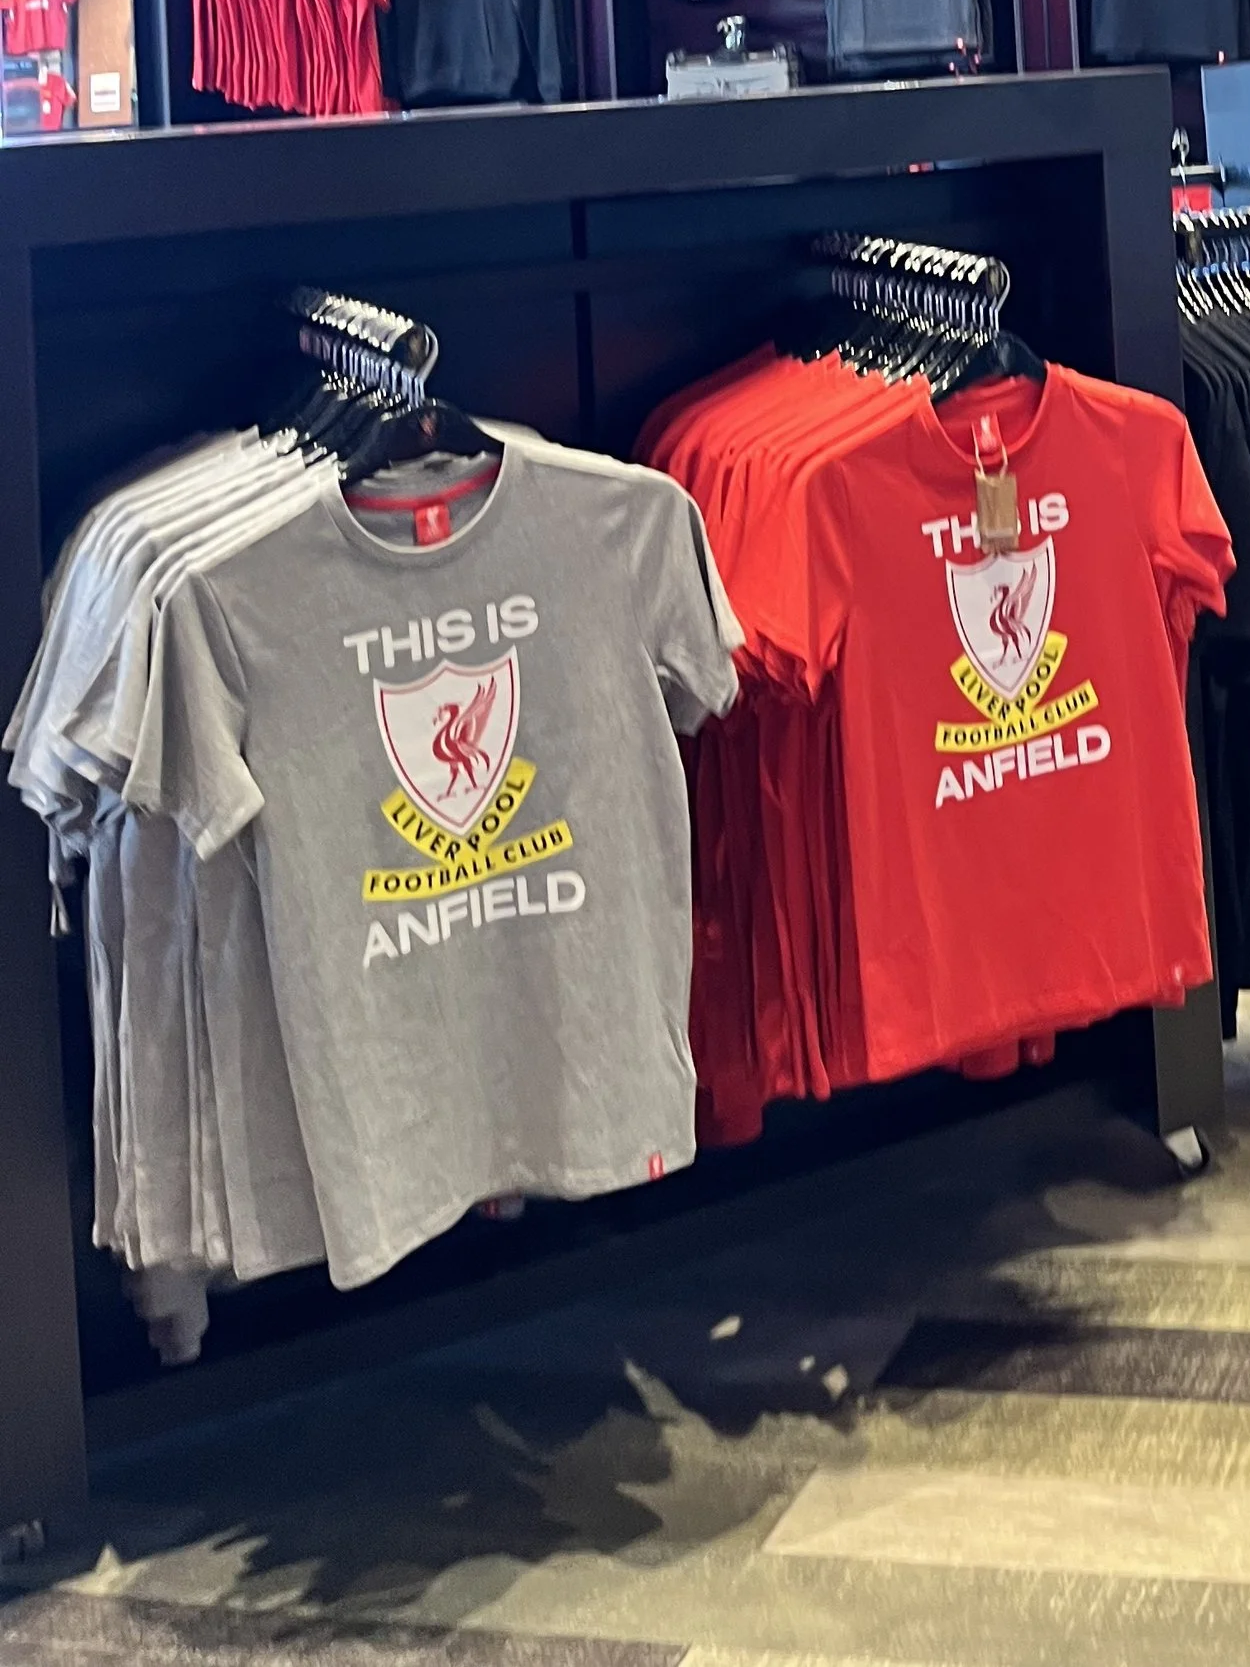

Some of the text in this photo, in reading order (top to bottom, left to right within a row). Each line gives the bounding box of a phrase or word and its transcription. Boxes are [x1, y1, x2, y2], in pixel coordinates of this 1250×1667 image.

[1028, 492, 1070, 535] IS
[343, 593, 539, 674] THIS IS
[942, 686, 1091, 747] FOOTBALL CLUB
[958, 646, 1060, 723] LIVERPOOL
[934, 724, 1111, 809] ANFIELD
[390, 777, 527, 863] LIVERPOOL
[368, 829, 564, 894] FOOTBALL CLUB
[362, 869, 587, 969] ANFIELD
